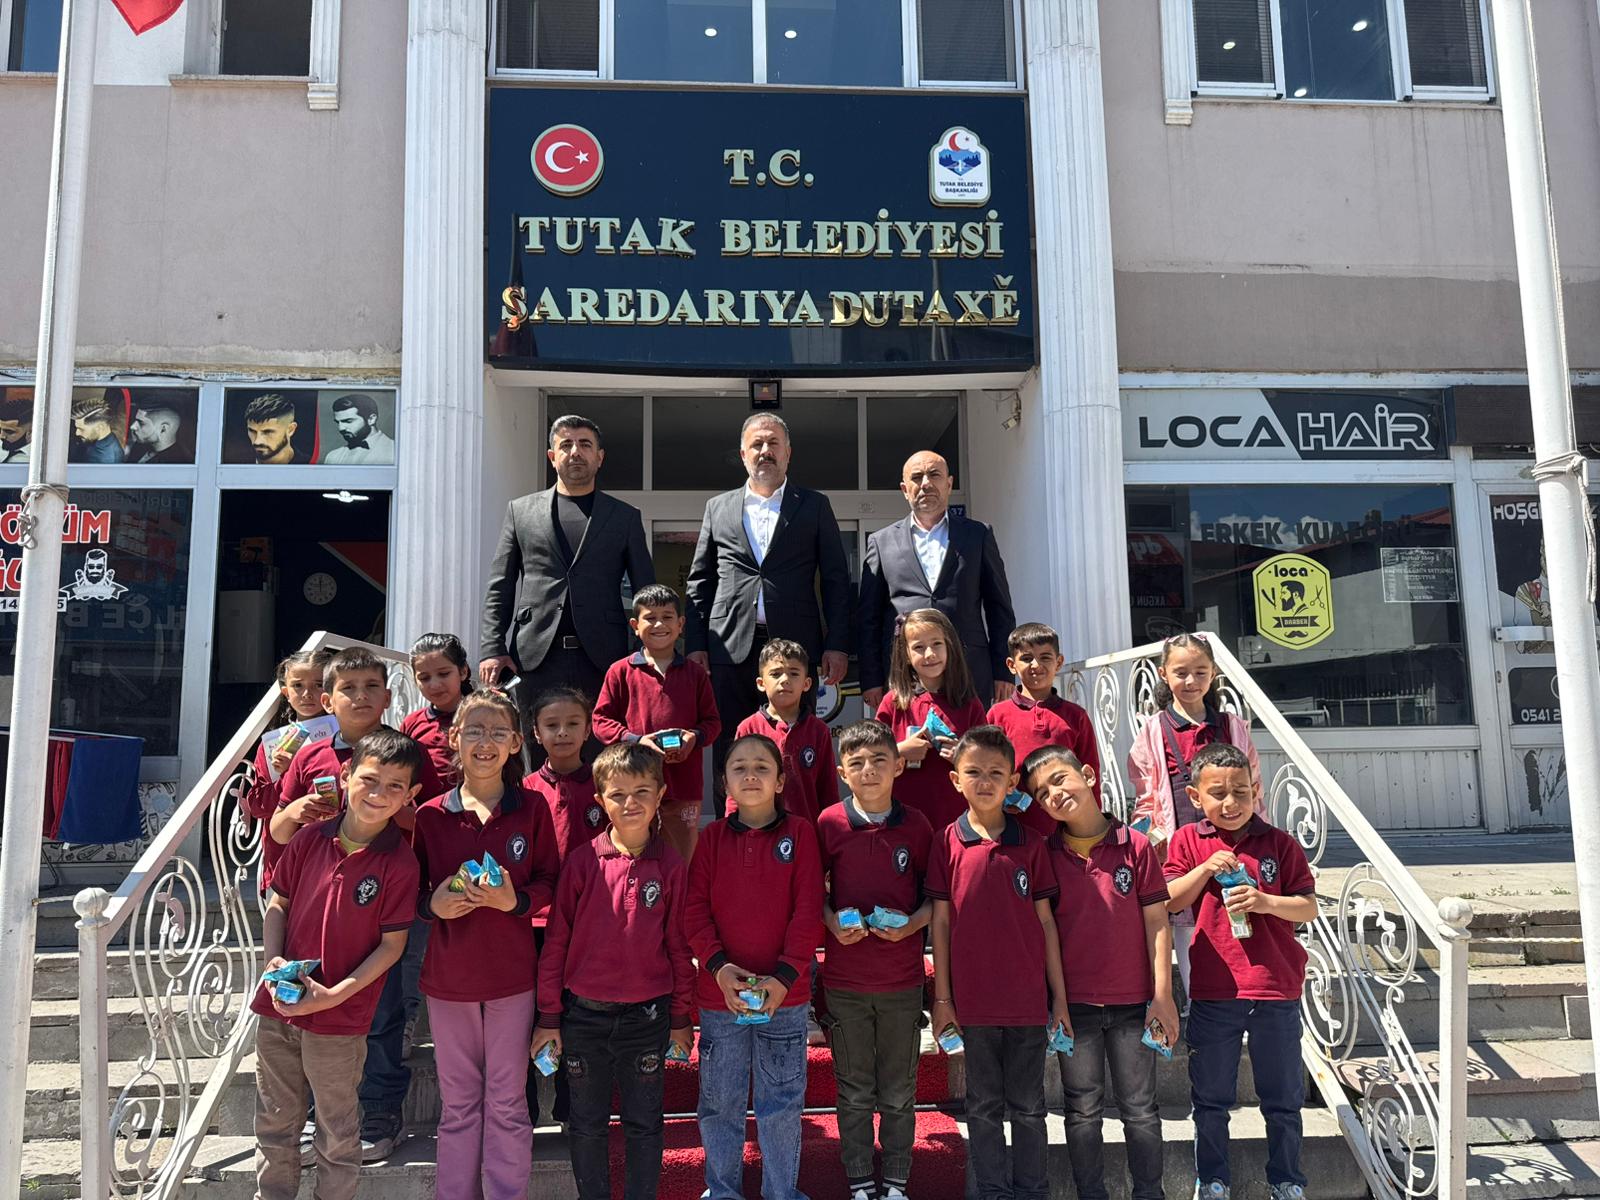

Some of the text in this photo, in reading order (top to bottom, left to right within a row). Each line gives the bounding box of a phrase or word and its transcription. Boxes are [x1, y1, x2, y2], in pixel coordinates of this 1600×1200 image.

[723, 148, 815, 186] T.C.
[518, 208, 1005, 258] TUTAK BELEDİYESİ
[501, 286, 824, 331] ŞAREDARIYA
[1139, 415, 1286, 448] LOCA
[1201, 521, 1283, 545] ERKEK
[1273, 564, 1309, 578] loca
[1521, 708, 1549, 722] 0541
